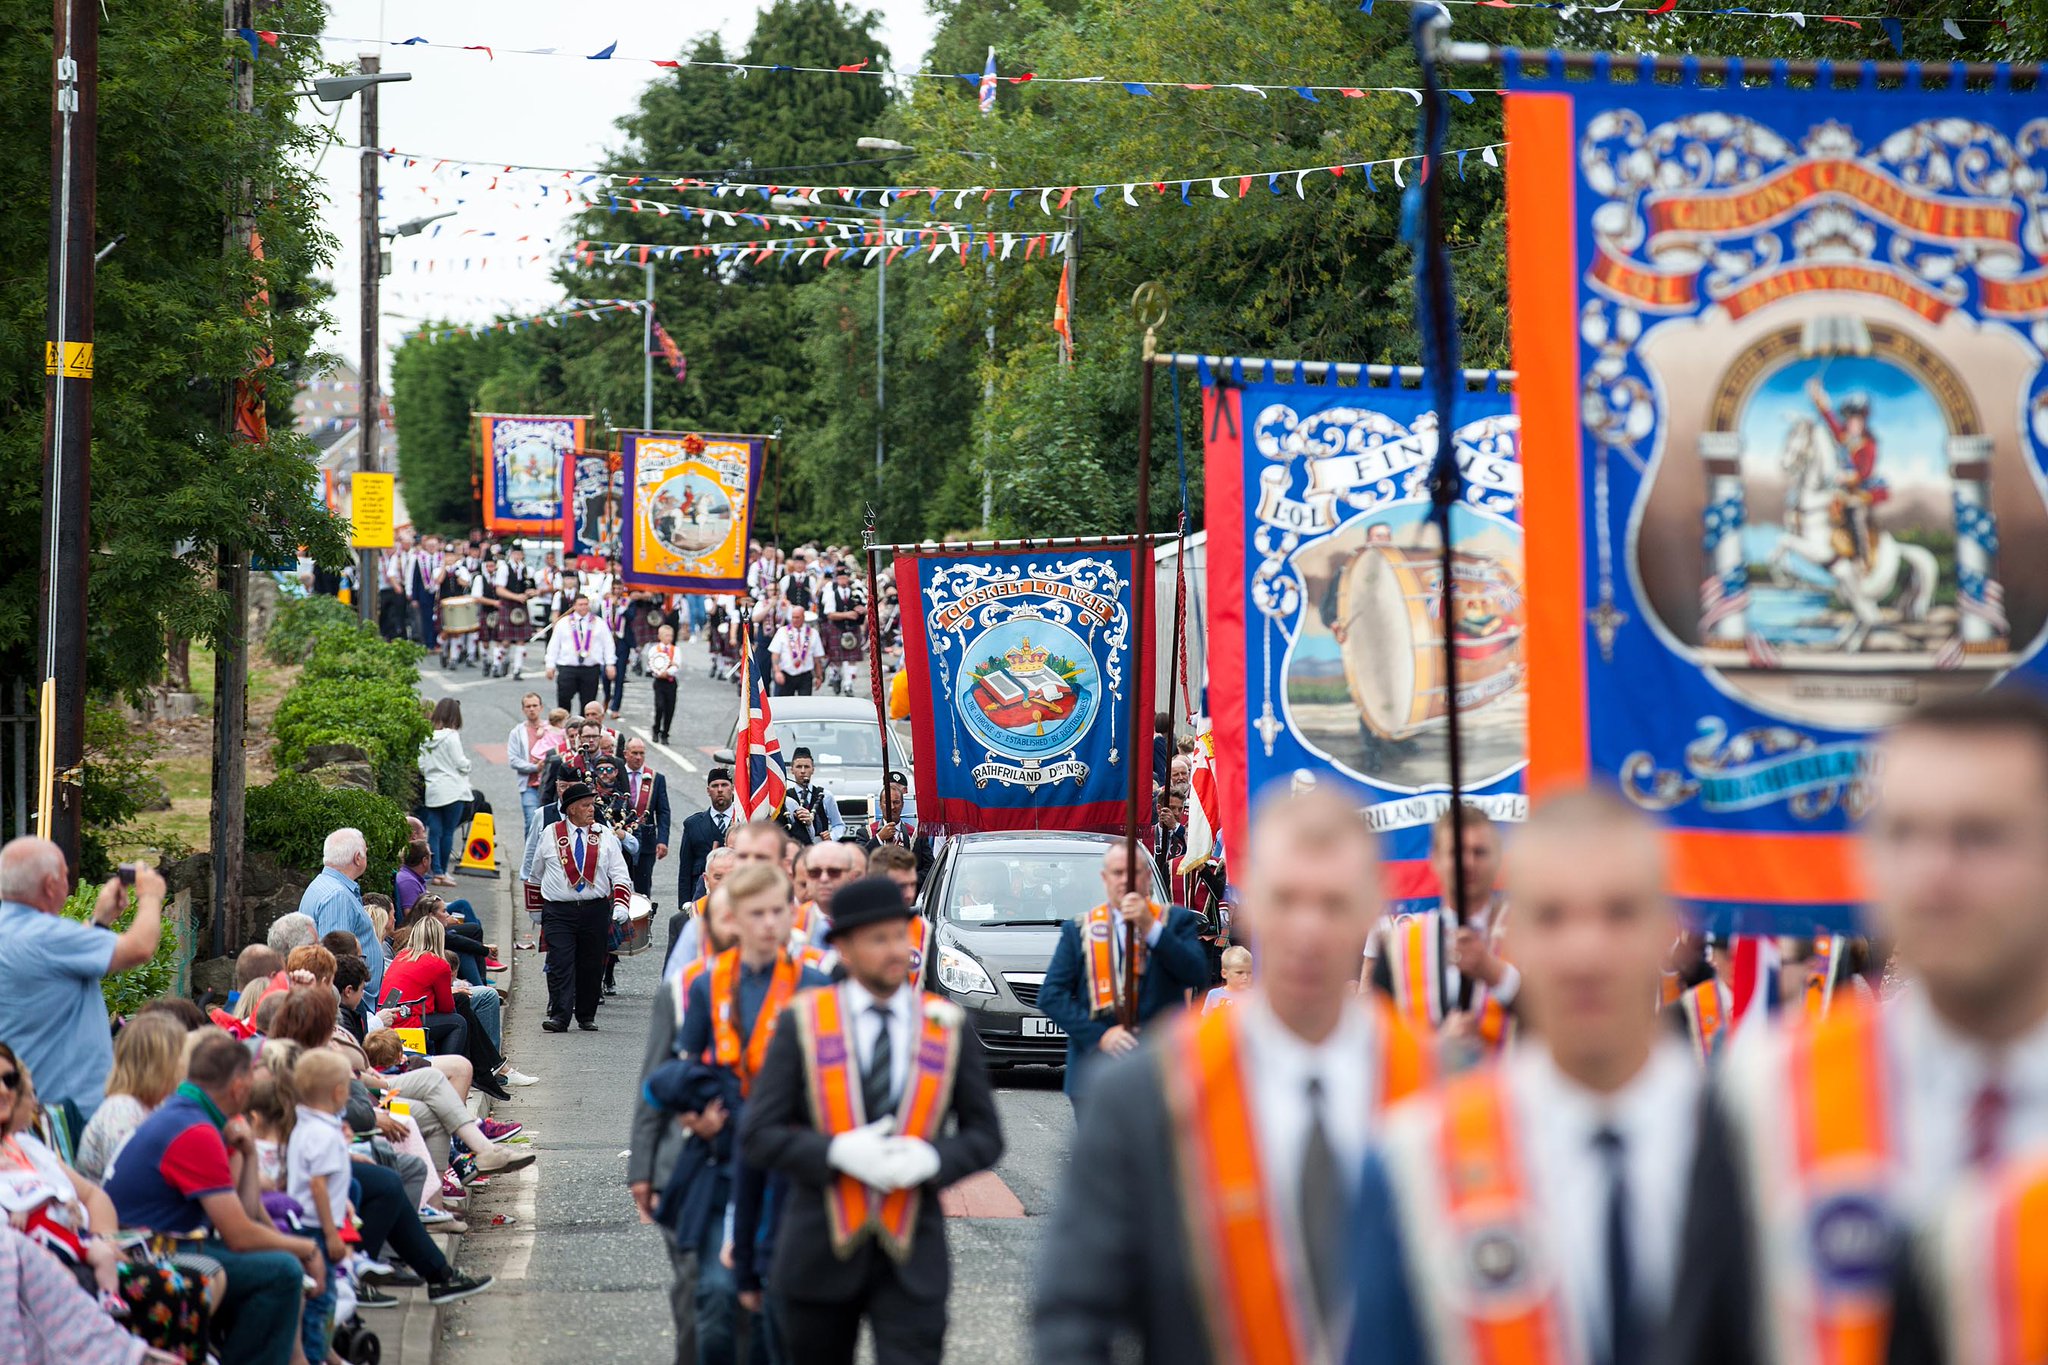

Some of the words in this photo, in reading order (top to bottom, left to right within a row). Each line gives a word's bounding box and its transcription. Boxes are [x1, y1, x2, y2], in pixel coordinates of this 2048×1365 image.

[946, 582, 1024, 620] CLOSKELT
[968, 700, 977, 714] THE
[975, 714, 994, 732] THRONE
[1005, 736, 1048, 746] ESTABLISHED
[1051, 735, 1060, 743] BY
[1061, 697, 1089, 738] RIGHTEOUSNESS
[973, 765, 1042, 781] RATHFRILAND
